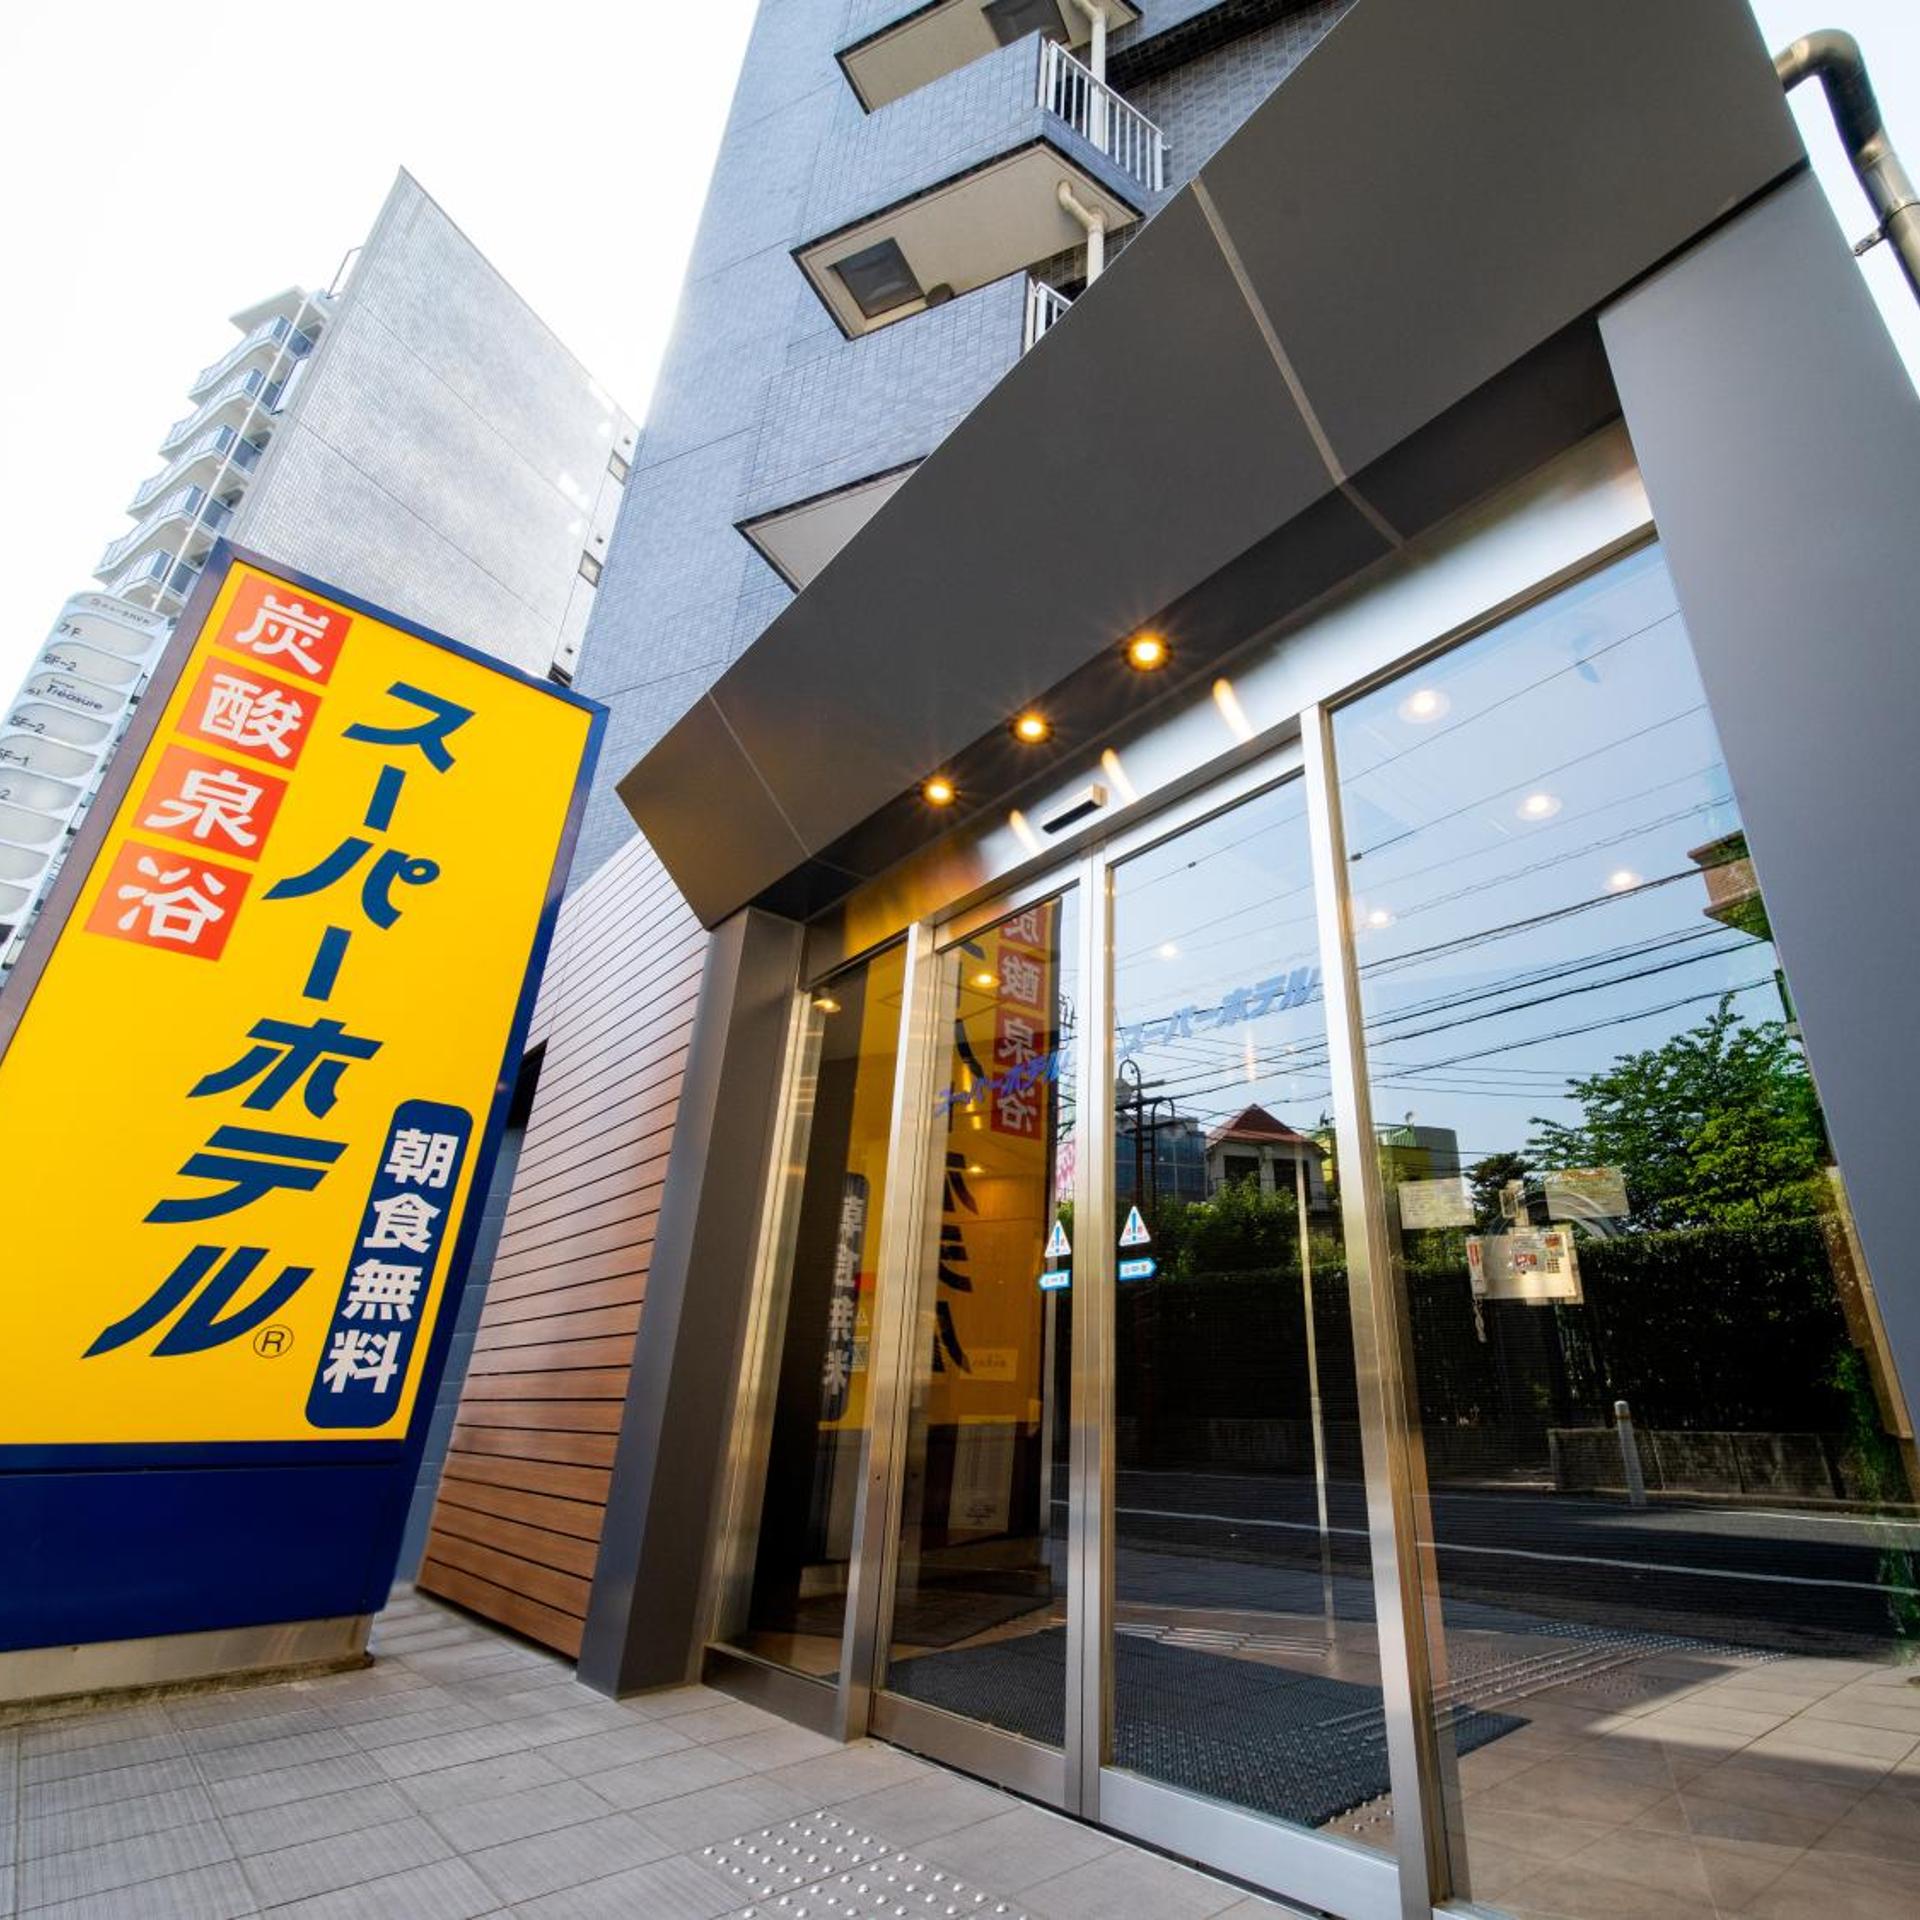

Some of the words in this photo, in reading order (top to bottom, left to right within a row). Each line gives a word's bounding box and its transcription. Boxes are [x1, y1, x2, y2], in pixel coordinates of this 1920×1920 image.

[46, 684, 103, 710] Treasure
[117, 594, 330, 946] 炭酸泉浴
[81, 681, 475, 1360] スーパーホテル
[322, 1127, 460, 1395] 朝食無料
